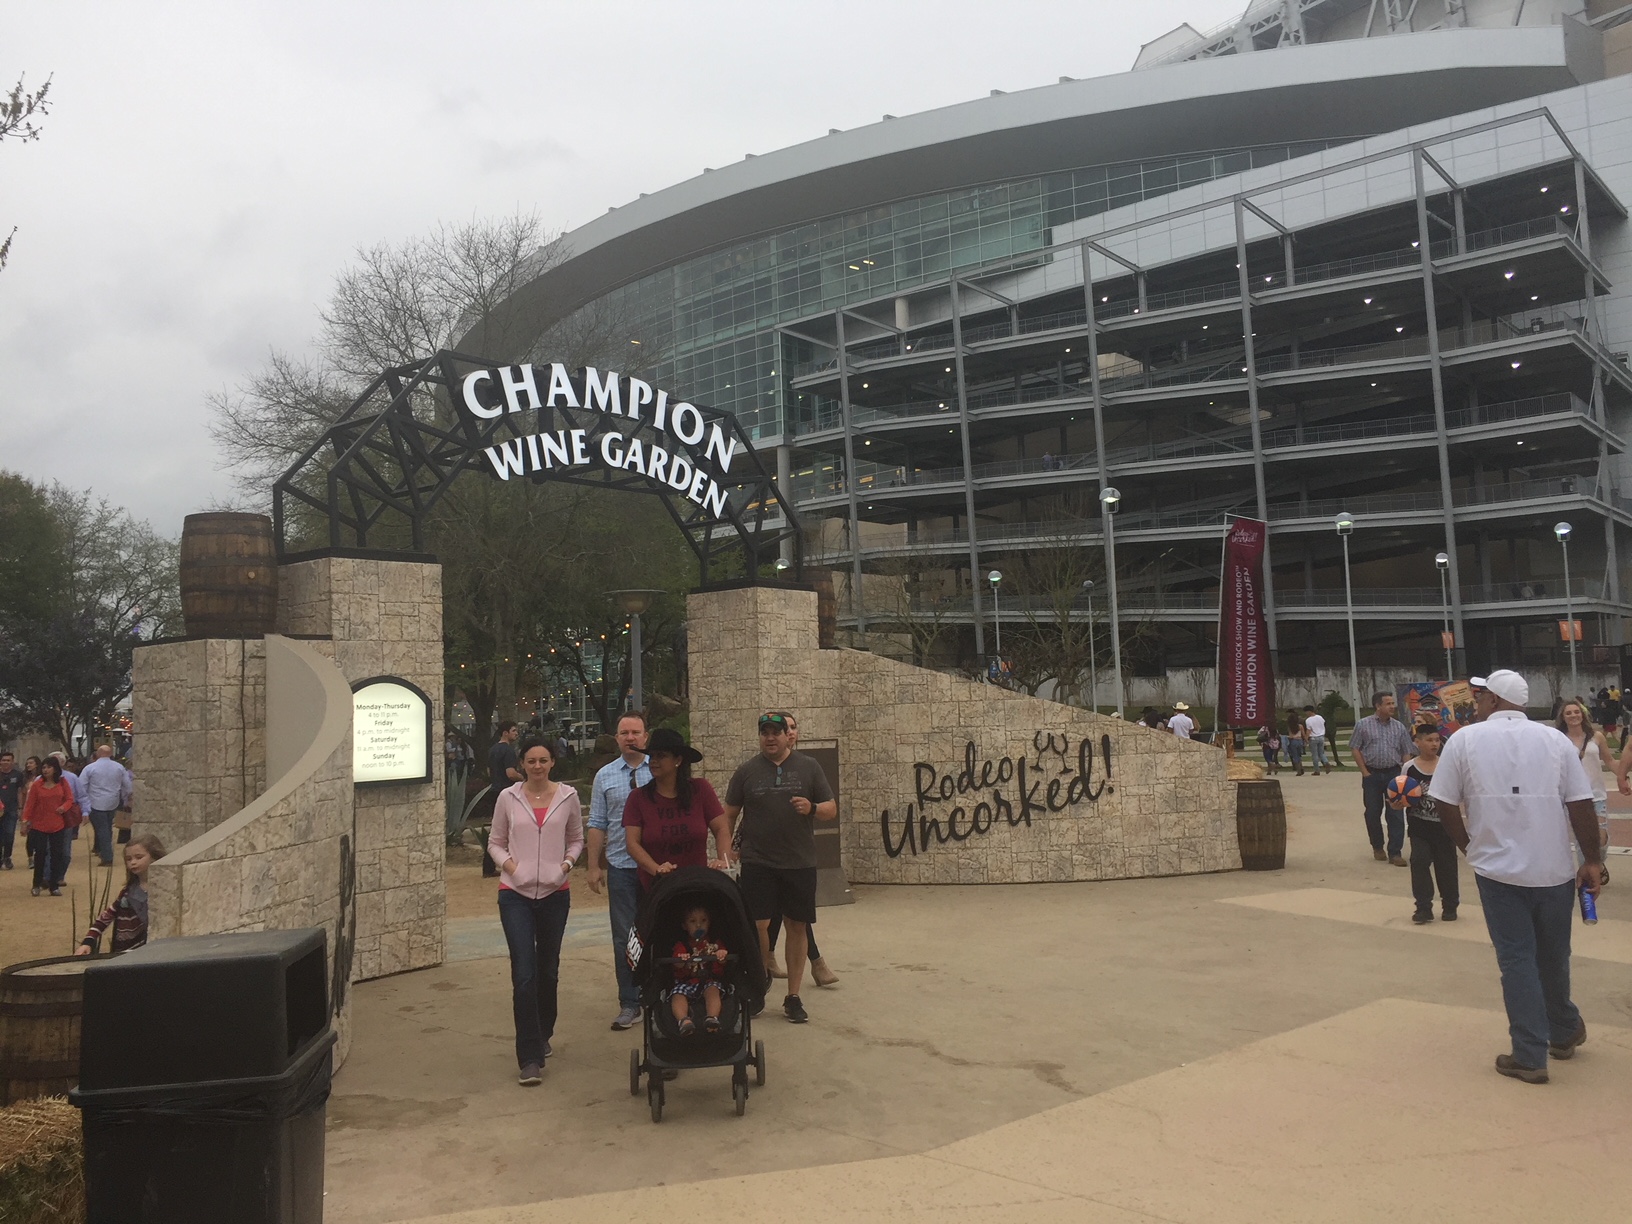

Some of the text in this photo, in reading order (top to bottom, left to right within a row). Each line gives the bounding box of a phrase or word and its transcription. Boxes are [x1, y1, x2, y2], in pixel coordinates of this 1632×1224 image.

[462, 362, 737, 474] CHAMPION
[484, 429, 729, 519] WINE GARDEN
[1247, 619, 1257, 650] WINE
[1246, 653, 1257, 720] CHAMPION
[356, 703, 411, 711] Monday-Thursday
[370, 736, 398, 744] Saturday
[384, 727, 410, 735] midnight
[384, 743, 411, 751] midnight
[393, 760, 405, 768] p.m.
[913, 741, 1013, 811] Rodeo
[881, 734, 1115, 858] Uncorked!
